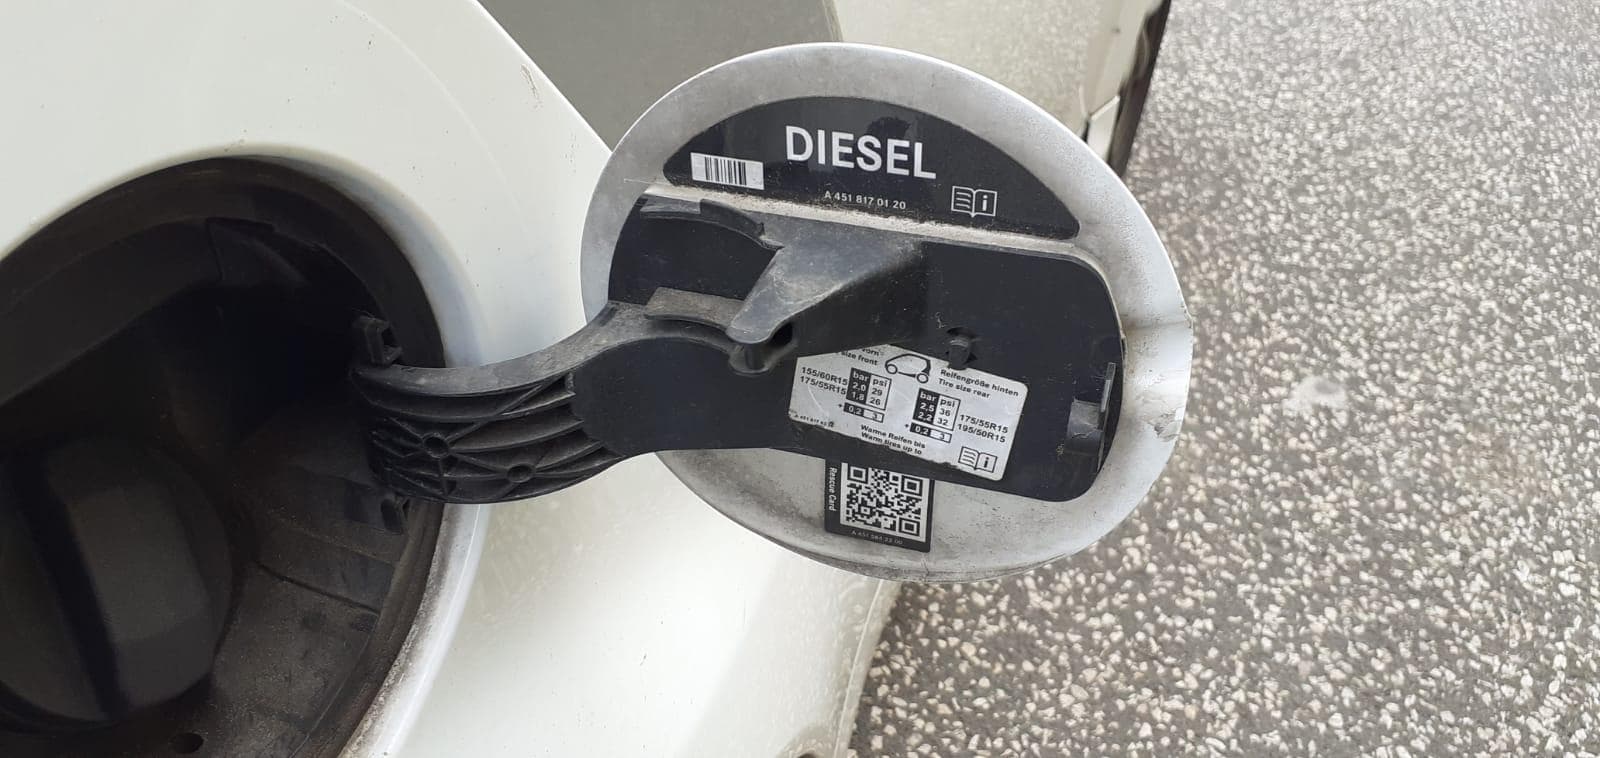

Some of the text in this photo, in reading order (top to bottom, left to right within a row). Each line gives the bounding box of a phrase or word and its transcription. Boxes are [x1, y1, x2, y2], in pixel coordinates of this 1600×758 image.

[785, 125, 936, 180] DIESEL
[824, 190, 906, 210] A 451 817 01 20
[858, 354, 878, 366] front
[800, 376, 846, 396] 175/55R15
[870, 396, 881, 406] 26
[801, 366, 848, 386] 155/60R15
[871, 387, 882, 396] 29
[853, 371, 888, 388] bar psi
[939, 378, 990, 399] Tire size rear
[940, 369, 1019, 397] Reifengröße hinten
[920, 391, 955, 408] bar psi
[937, 417, 948, 426] 32
[958, 424, 1006, 443] 195/50R15
[939, 408, 951, 416] 36
[960, 414, 1008, 434] 175/55R15
[861, 424, 926, 449] Warme Reifen bis
[861, 432, 883, 443] Warm
[903, 445, 913, 453] up
[829, 467, 838, 511] Rescue Card
